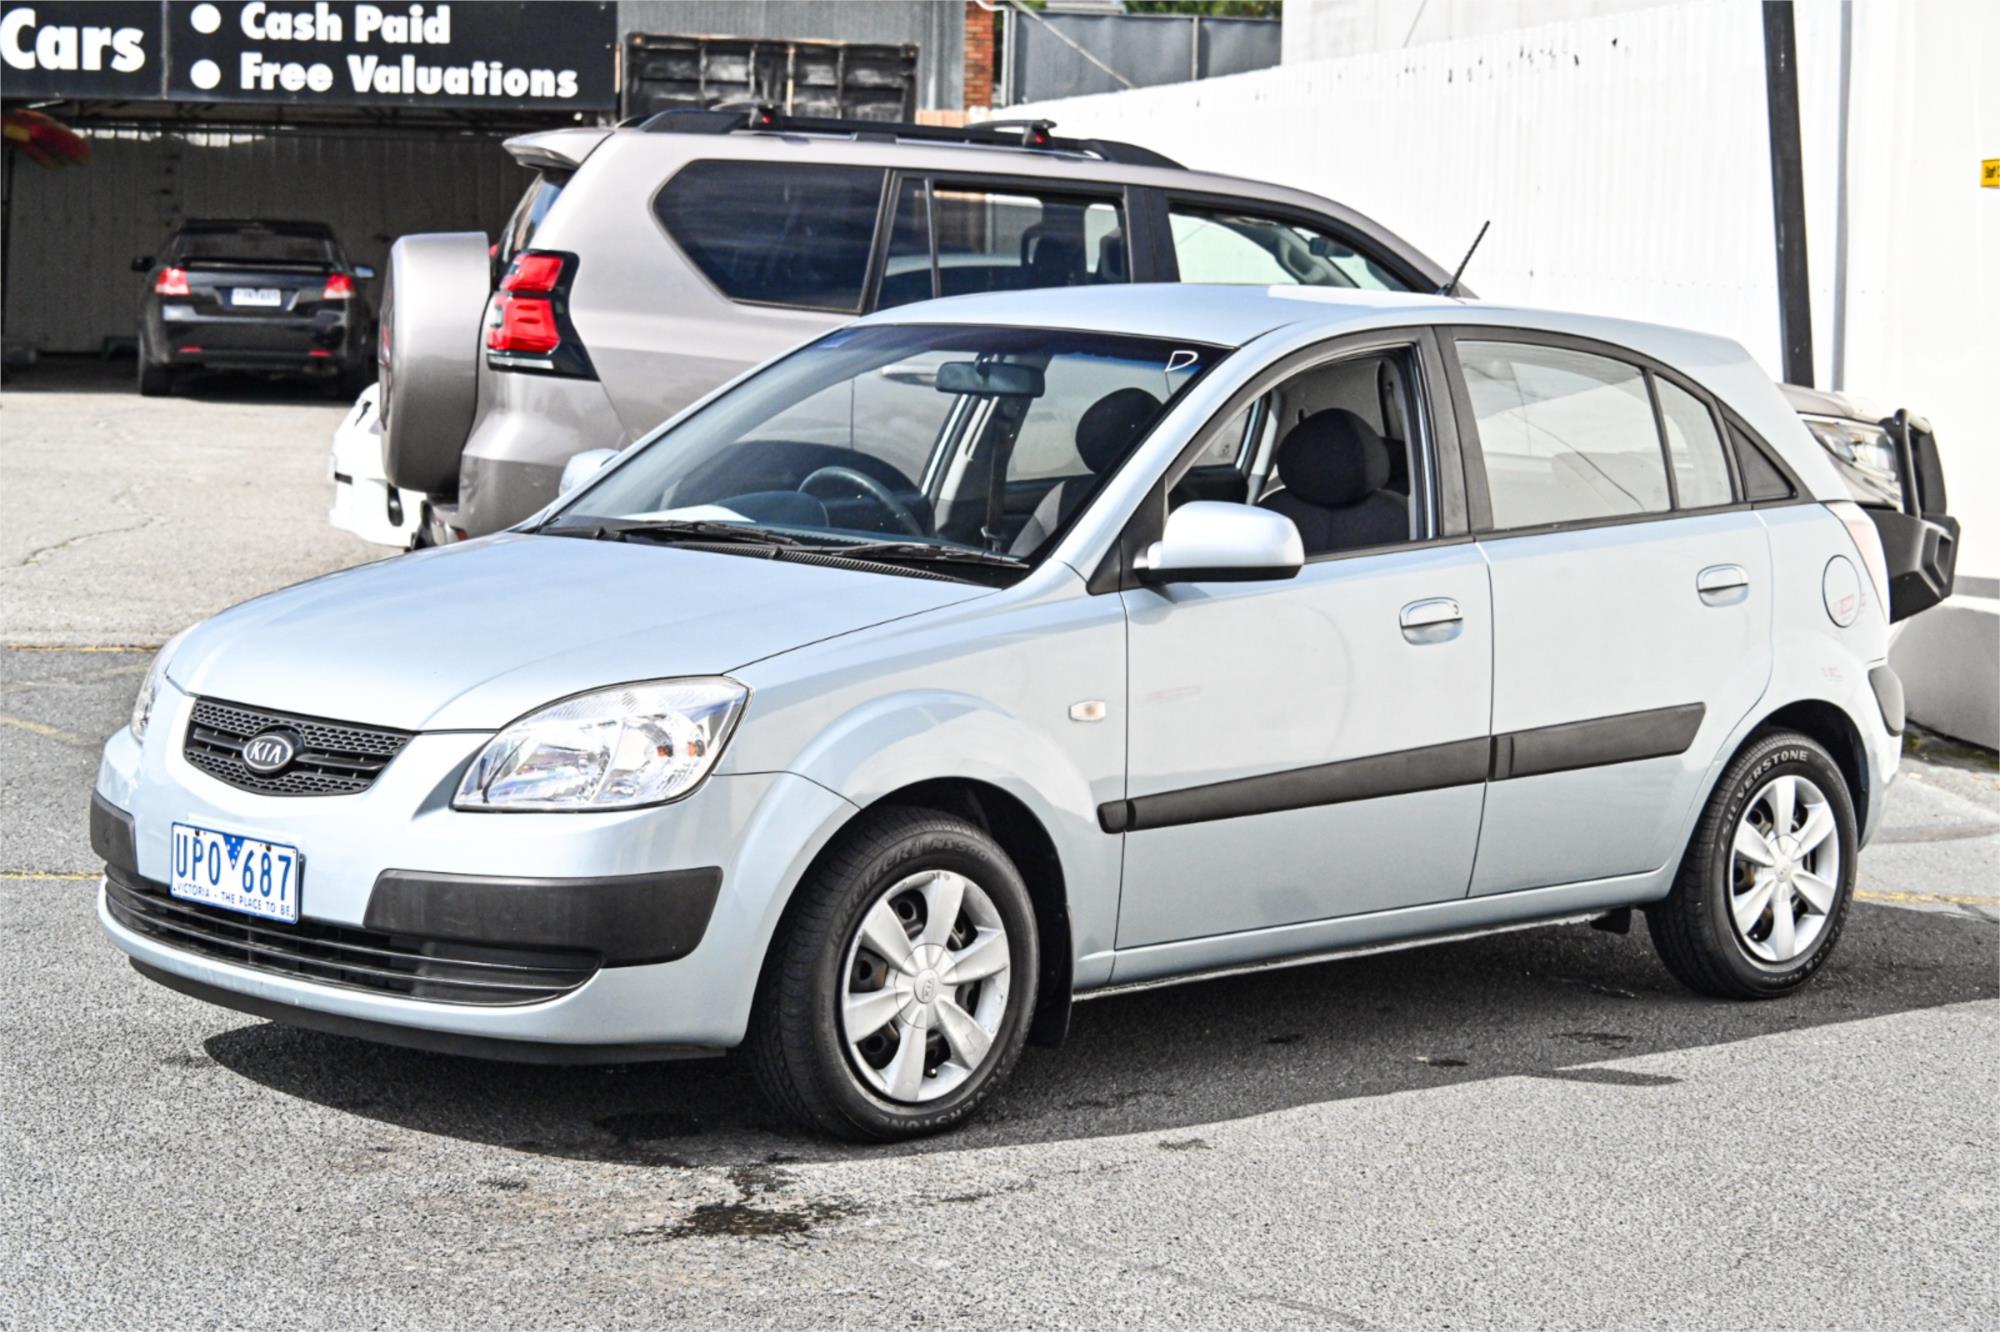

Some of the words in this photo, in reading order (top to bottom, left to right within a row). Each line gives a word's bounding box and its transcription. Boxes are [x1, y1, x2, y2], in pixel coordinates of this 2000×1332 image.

[0, 7, 146, 72] Cars
[241, 1, 343, 42] Cash
[355, 3, 451, 45] Paid
[240, 52, 333, 93] Free
[347, 54, 579, 98] Valuations
[250, 741, 282, 764] KIA
[175, 832, 222, 886] UPO
[242, 849, 292, 901] 687
[177, 882, 210, 898] VICTORIA
[221, 891, 235, 904] THE
[239, 895, 262, 911] PLACE
[265, 901, 276, 913] TO
[280, 904, 290, 917] BE
